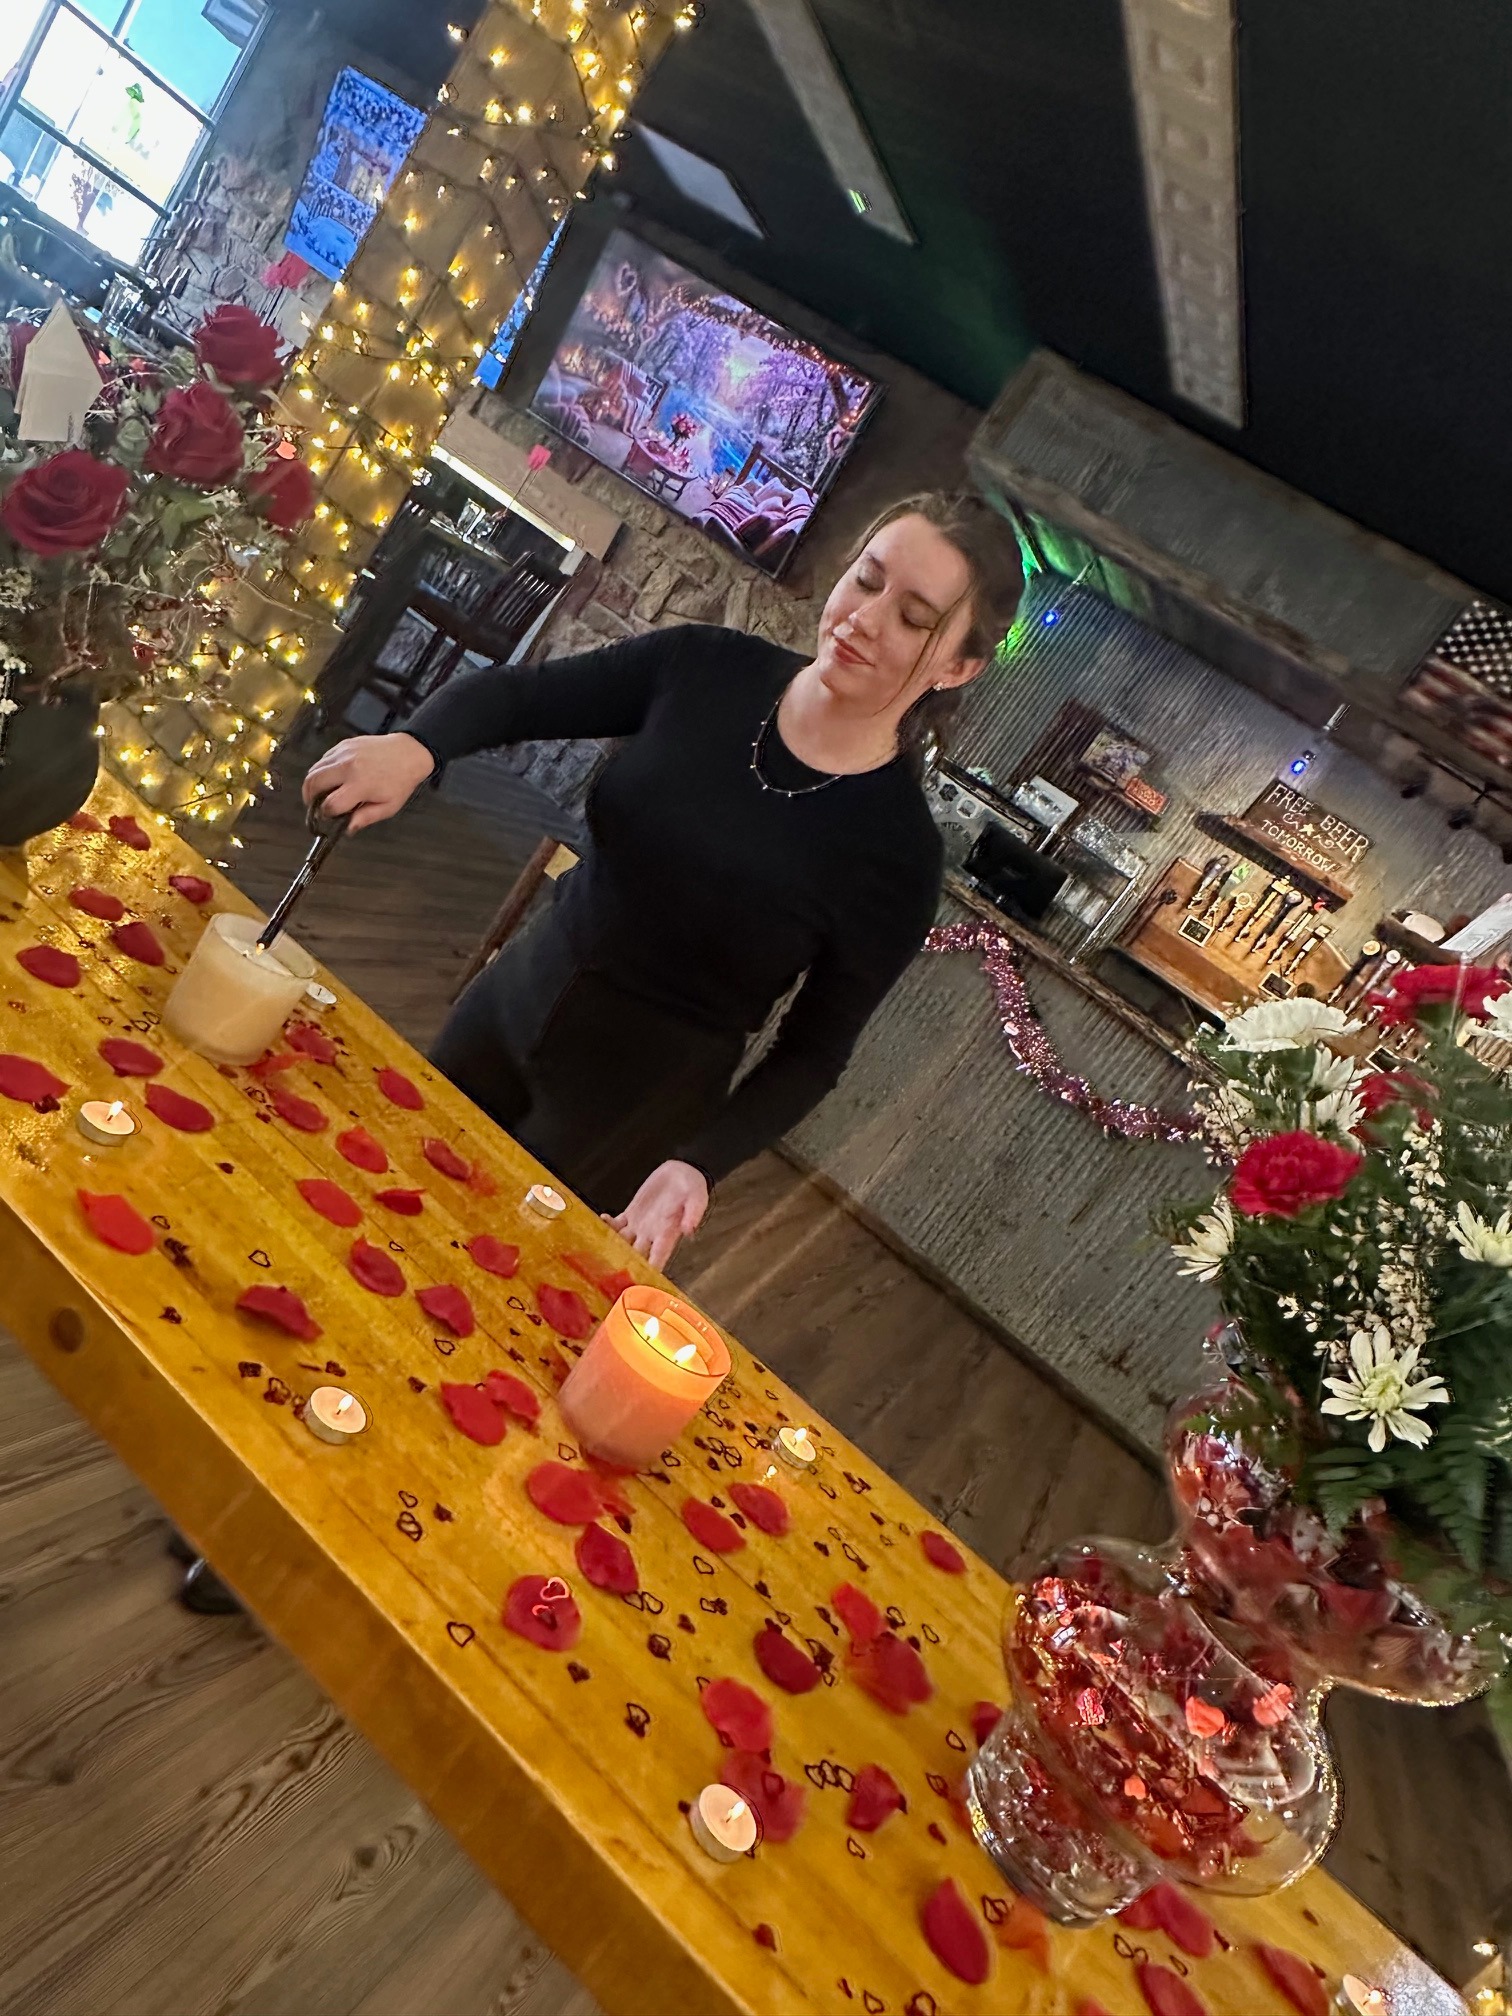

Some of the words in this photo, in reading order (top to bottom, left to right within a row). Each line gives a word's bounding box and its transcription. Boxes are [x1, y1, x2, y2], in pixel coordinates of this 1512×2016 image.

[1261, 819, 1336, 872] TOMORROW
[1265, 784, 1314, 814] FREE
[1320, 815, 1369, 862] BEER
